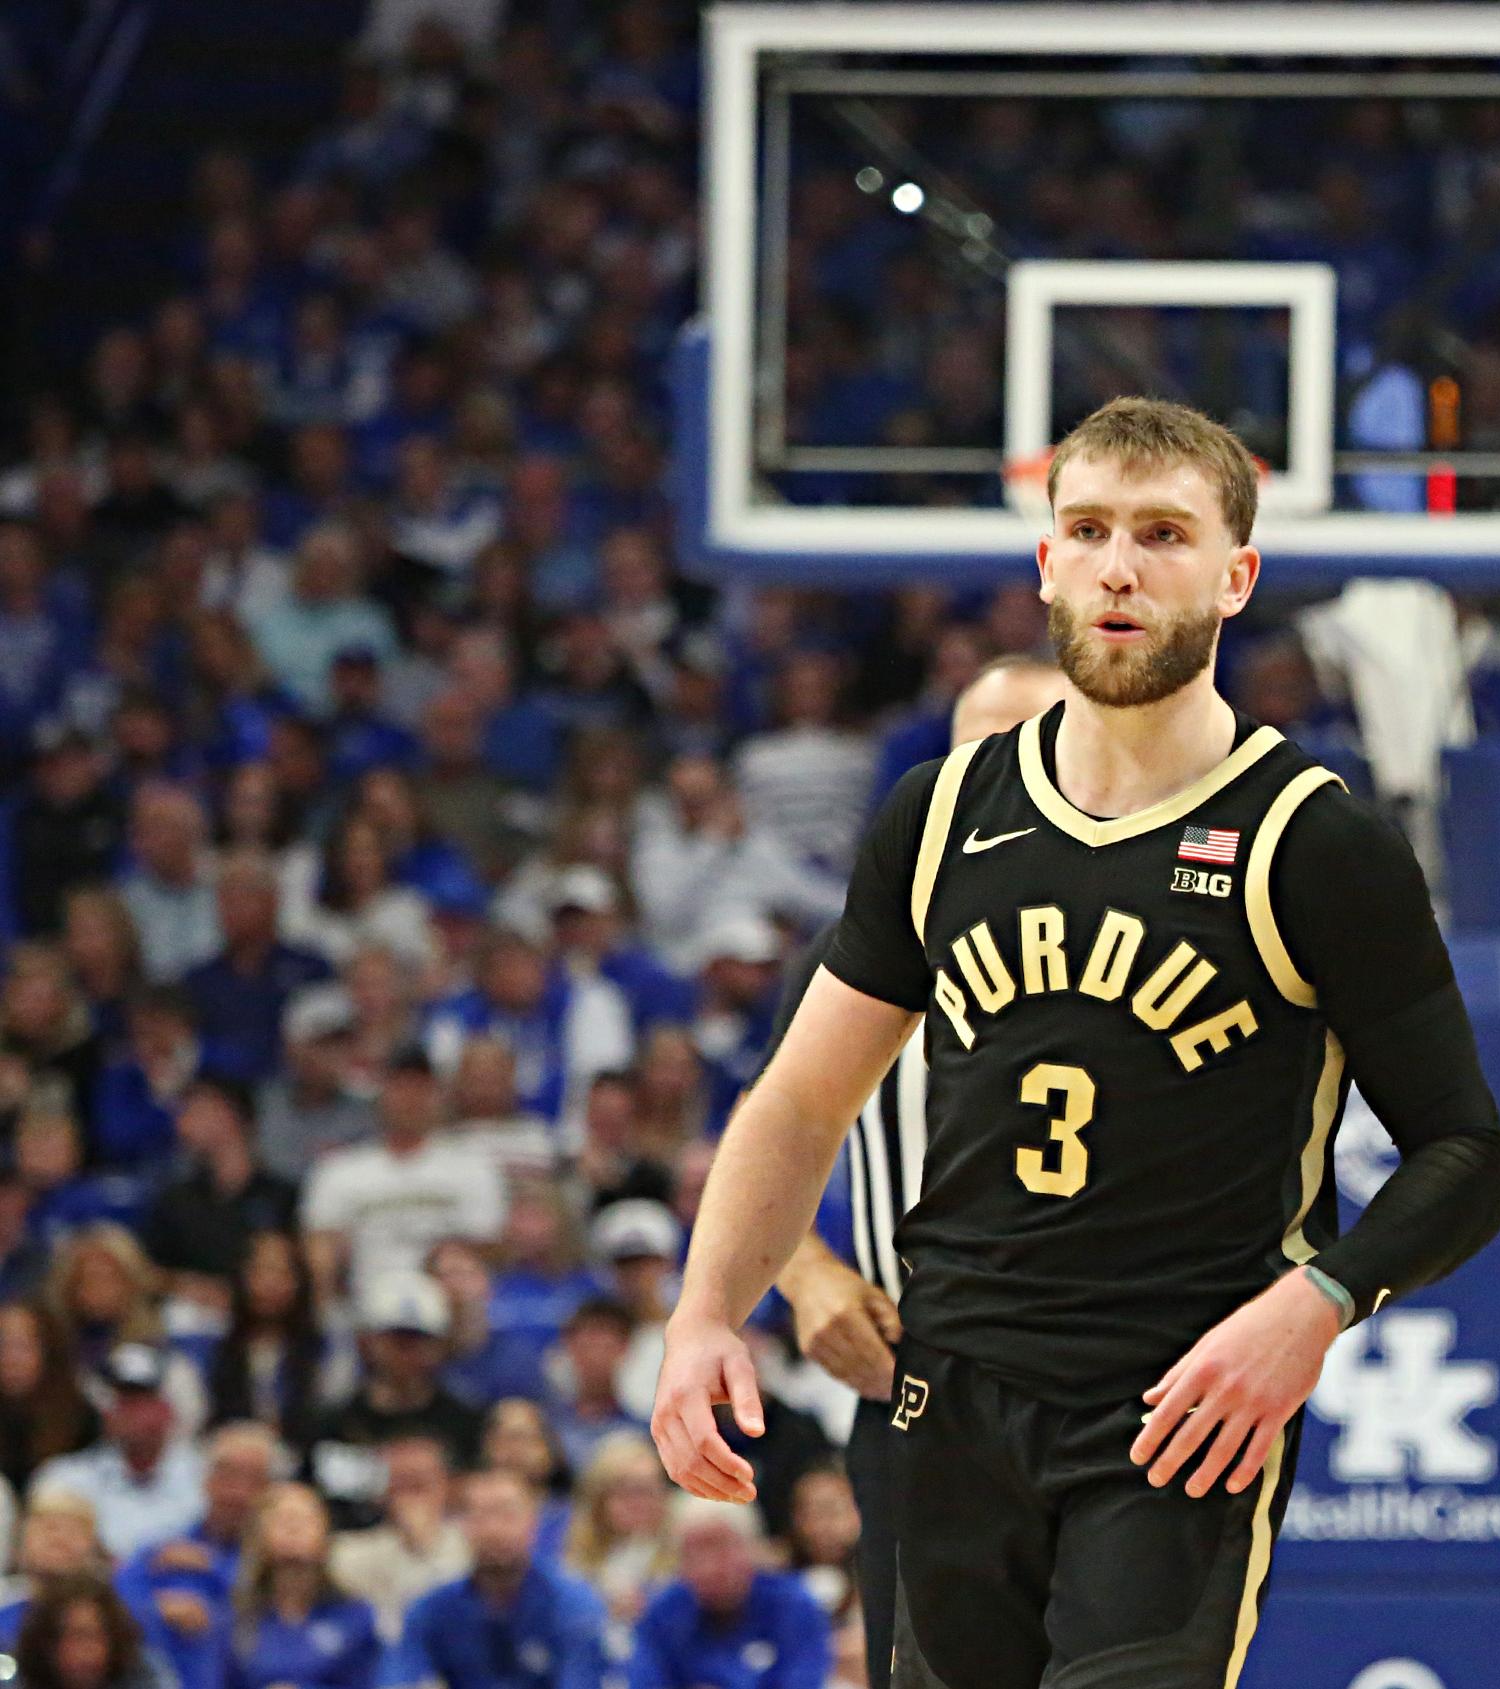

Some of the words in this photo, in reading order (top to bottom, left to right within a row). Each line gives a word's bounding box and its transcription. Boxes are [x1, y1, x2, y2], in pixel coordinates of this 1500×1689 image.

[933, 905, 1259, 1074] PURDUE
[1016, 1064, 1096, 1199] 3
[891, 1374, 929, 1432] P
